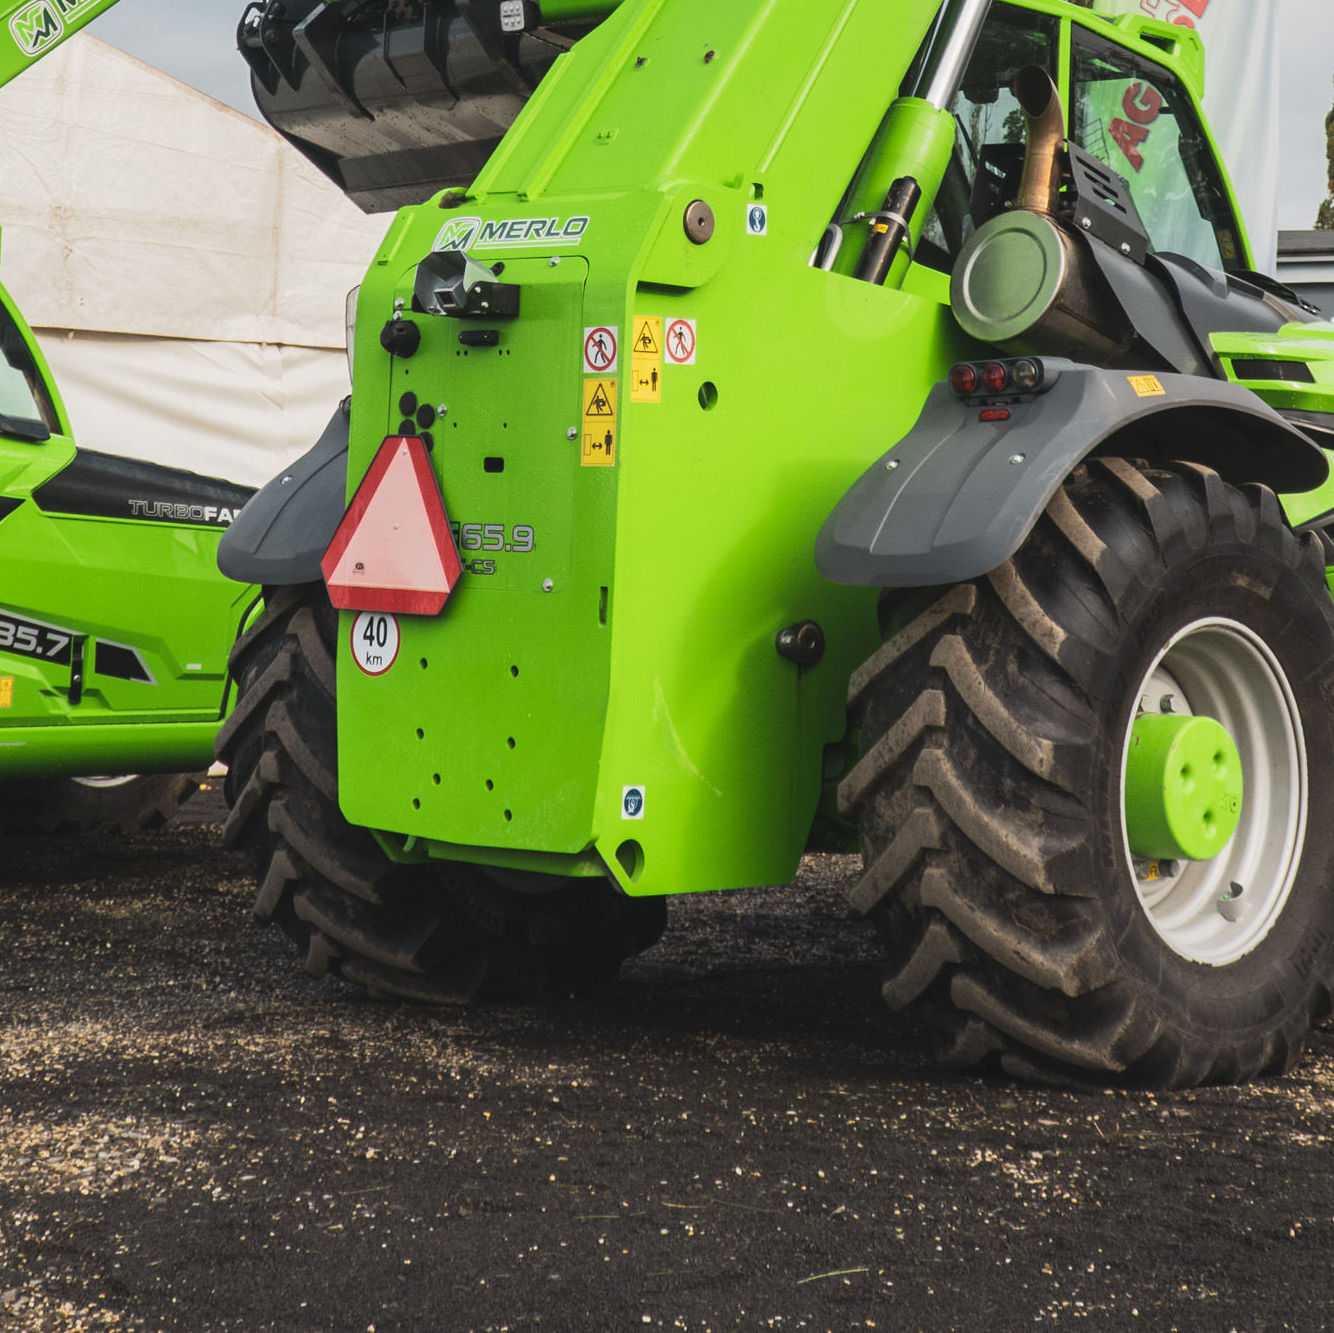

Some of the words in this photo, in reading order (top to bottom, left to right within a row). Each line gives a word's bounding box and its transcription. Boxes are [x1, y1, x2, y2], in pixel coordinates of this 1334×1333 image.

[478, 217, 589, 240] MERLO
[362, 616, 388, 648] 40
[365, 651, 383, 666] km
